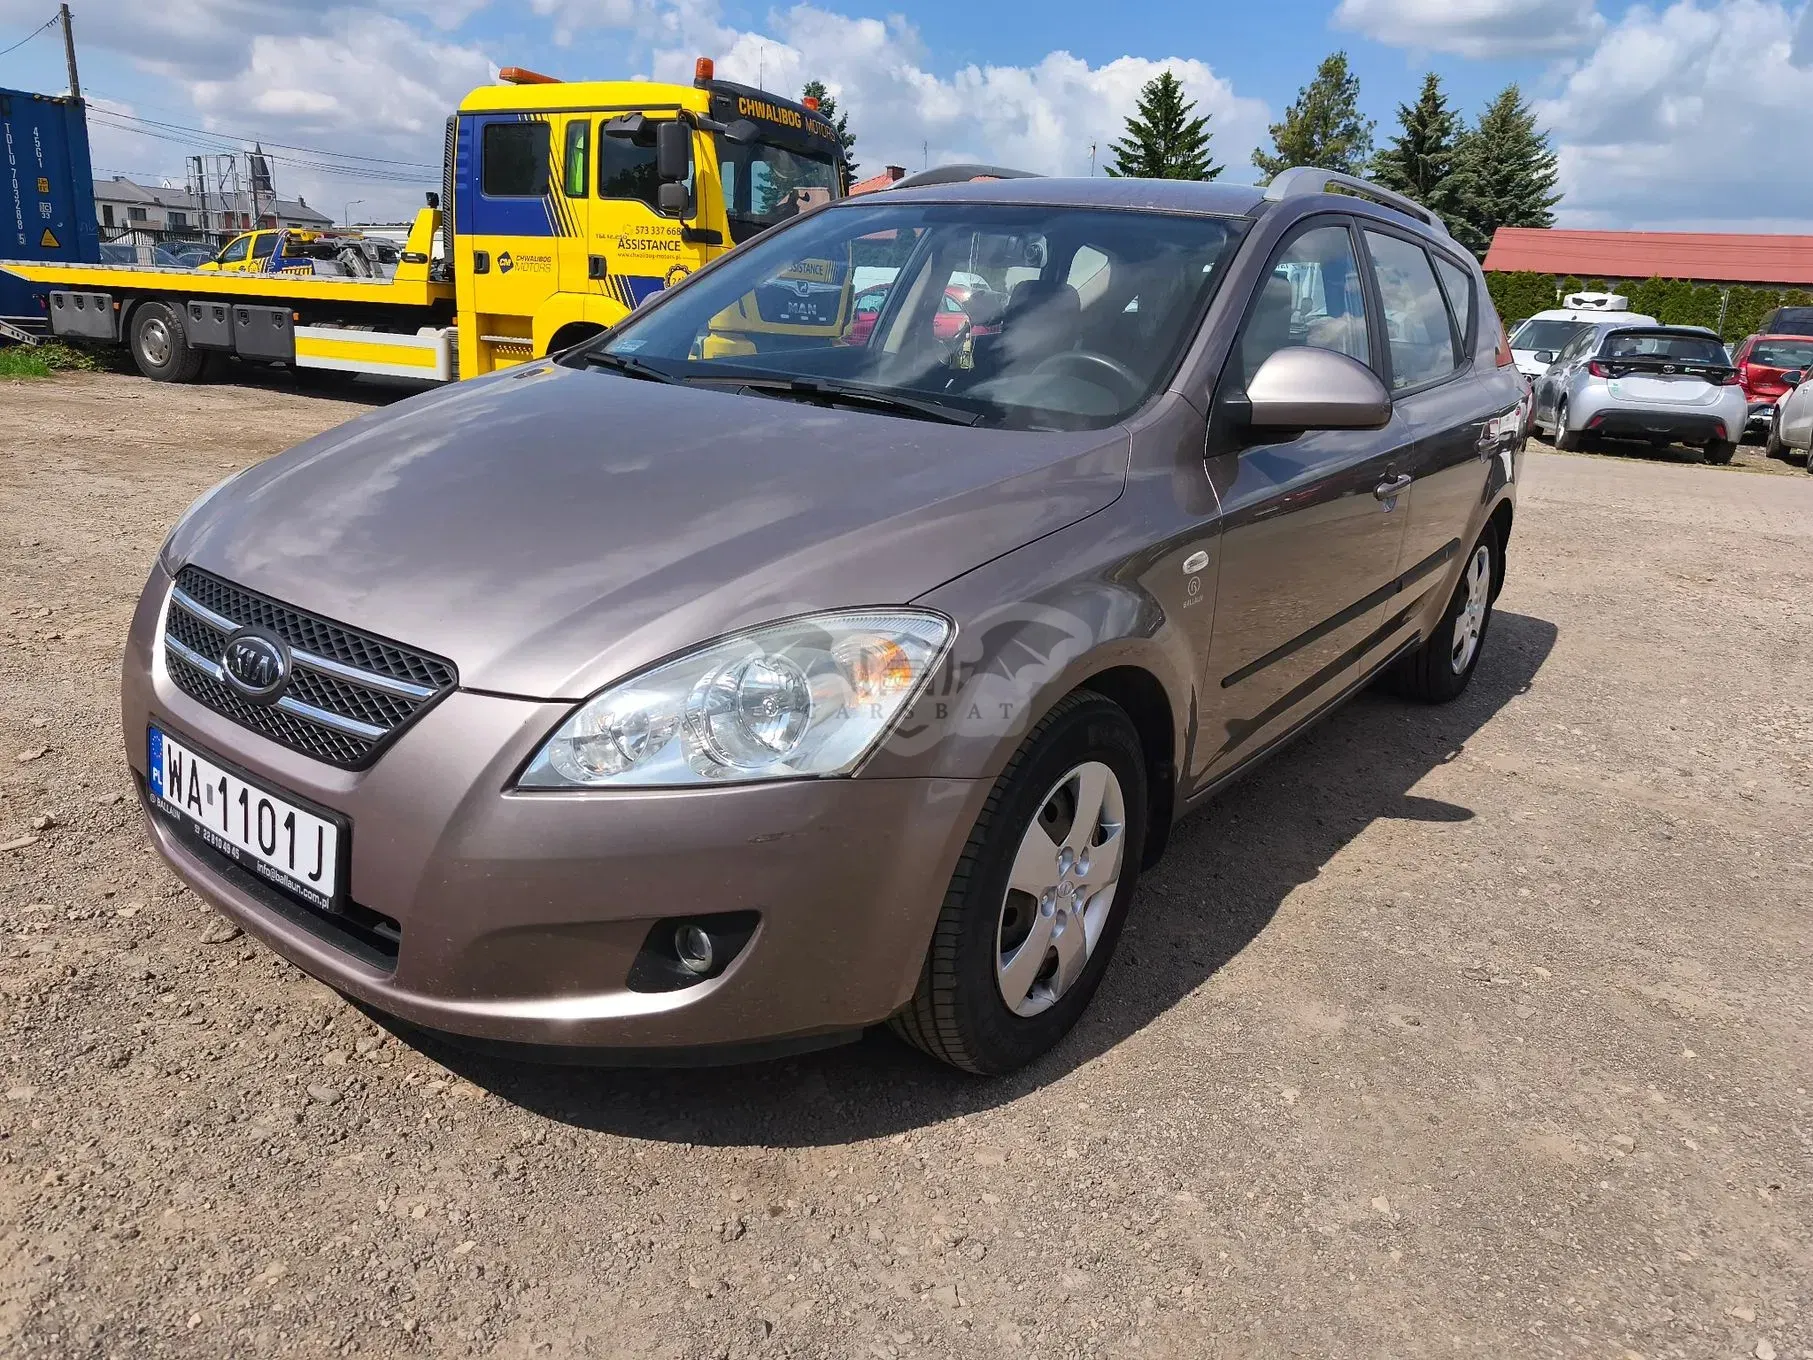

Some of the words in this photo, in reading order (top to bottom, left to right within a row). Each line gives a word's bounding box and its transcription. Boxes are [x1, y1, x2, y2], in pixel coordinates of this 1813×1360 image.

[738, 97, 802, 129] CHWALIBOG
[804, 116, 836, 142] MOTORS
[33, 126, 43, 169] 45G1
[635, 225, 649, 235] 573
[651, 226, 664, 235] 337
[666, 227, 681, 236] 668
[617, 238, 681, 252] ASSISTANCE
[514, 262, 552, 273] MOTORS
[788, 301, 817, 316] MAN
[152, 765, 163, 786] PL
[156, 797, 182, 822] BALLAUN
[167, 743, 203, 818] WA
[217, 775, 324, 882] 1101J
[256, 860, 330, 910] info@ballaun.com.pl
